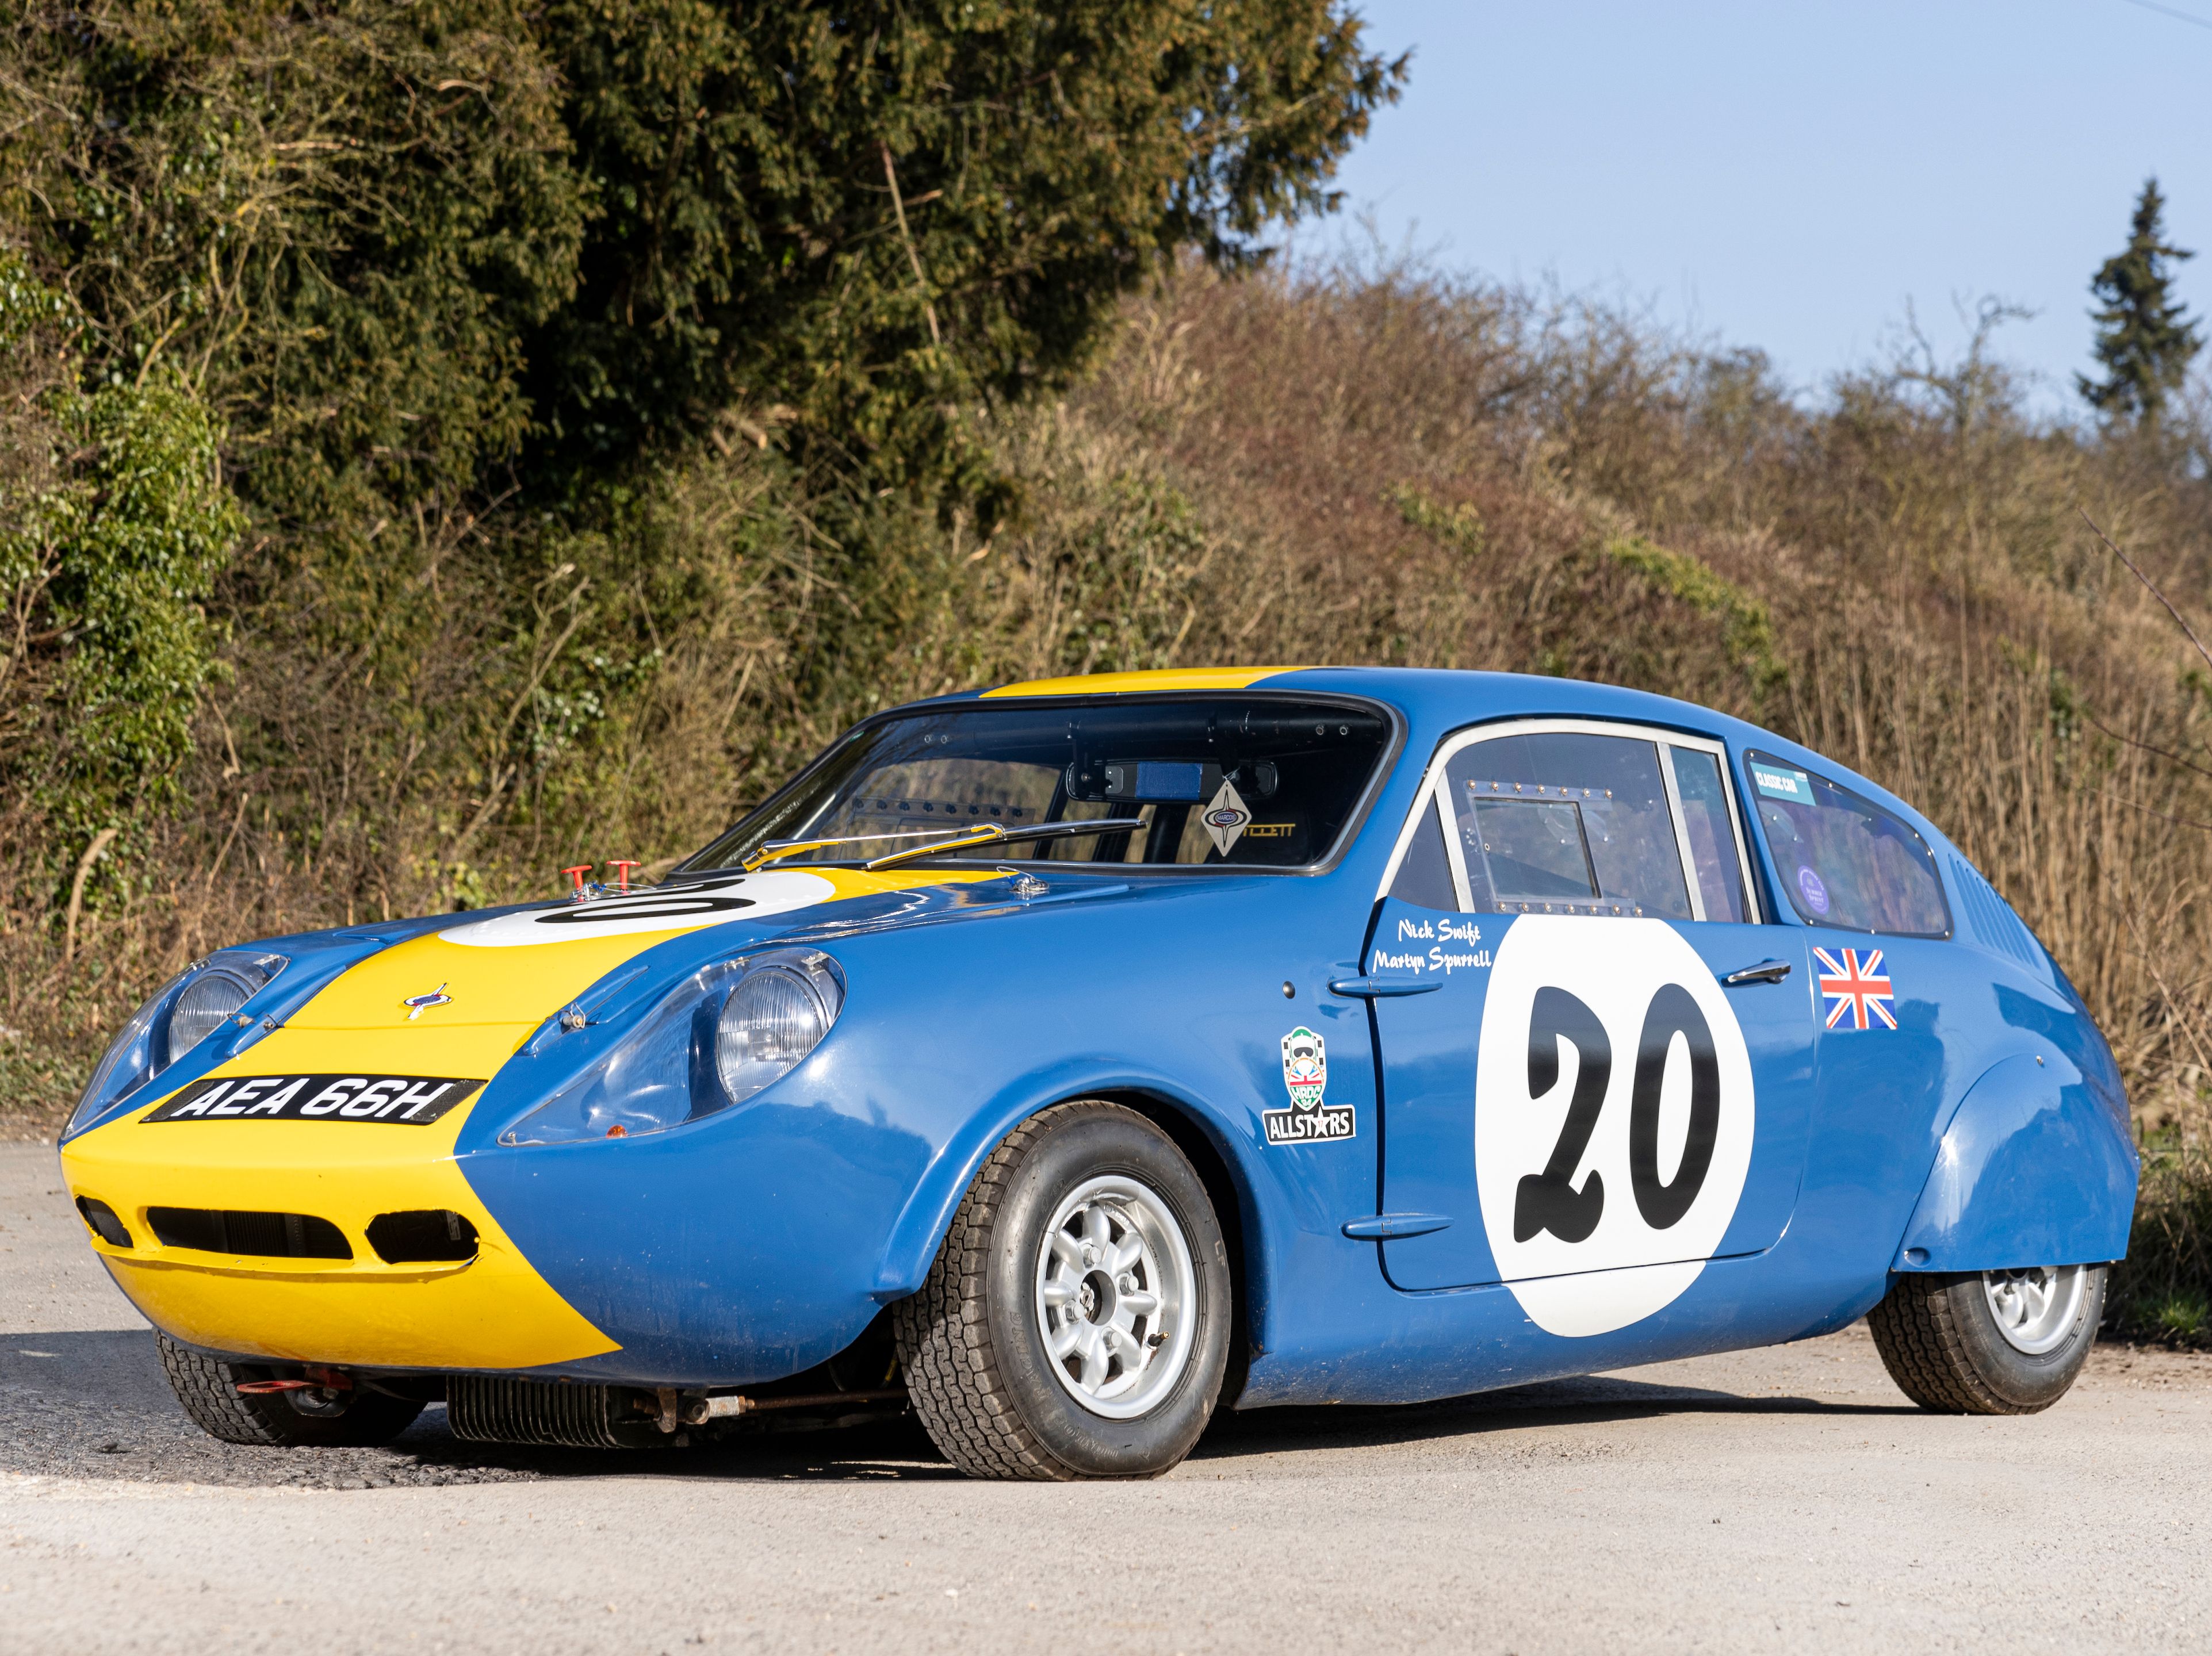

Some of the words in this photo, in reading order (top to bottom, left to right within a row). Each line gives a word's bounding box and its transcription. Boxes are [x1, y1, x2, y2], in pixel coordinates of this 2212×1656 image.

[1755, 771, 1784, 791] CLASSIC
[1782, 777, 1798, 793] CAR
[1398, 918, 1434, 942] Nick
[1438, 918, 1481, 947] Swift
[1372, 949, 1425, 975] Martyn
[1429, 946, 1491, 975] Spurrell
[170, 1078, 310, 1117] AEA
[300, 1078, 454, 1120] 66H
[1290, 1085, 1323, 1100] HRDC
[1514, 983, 1720, 1243] 20
